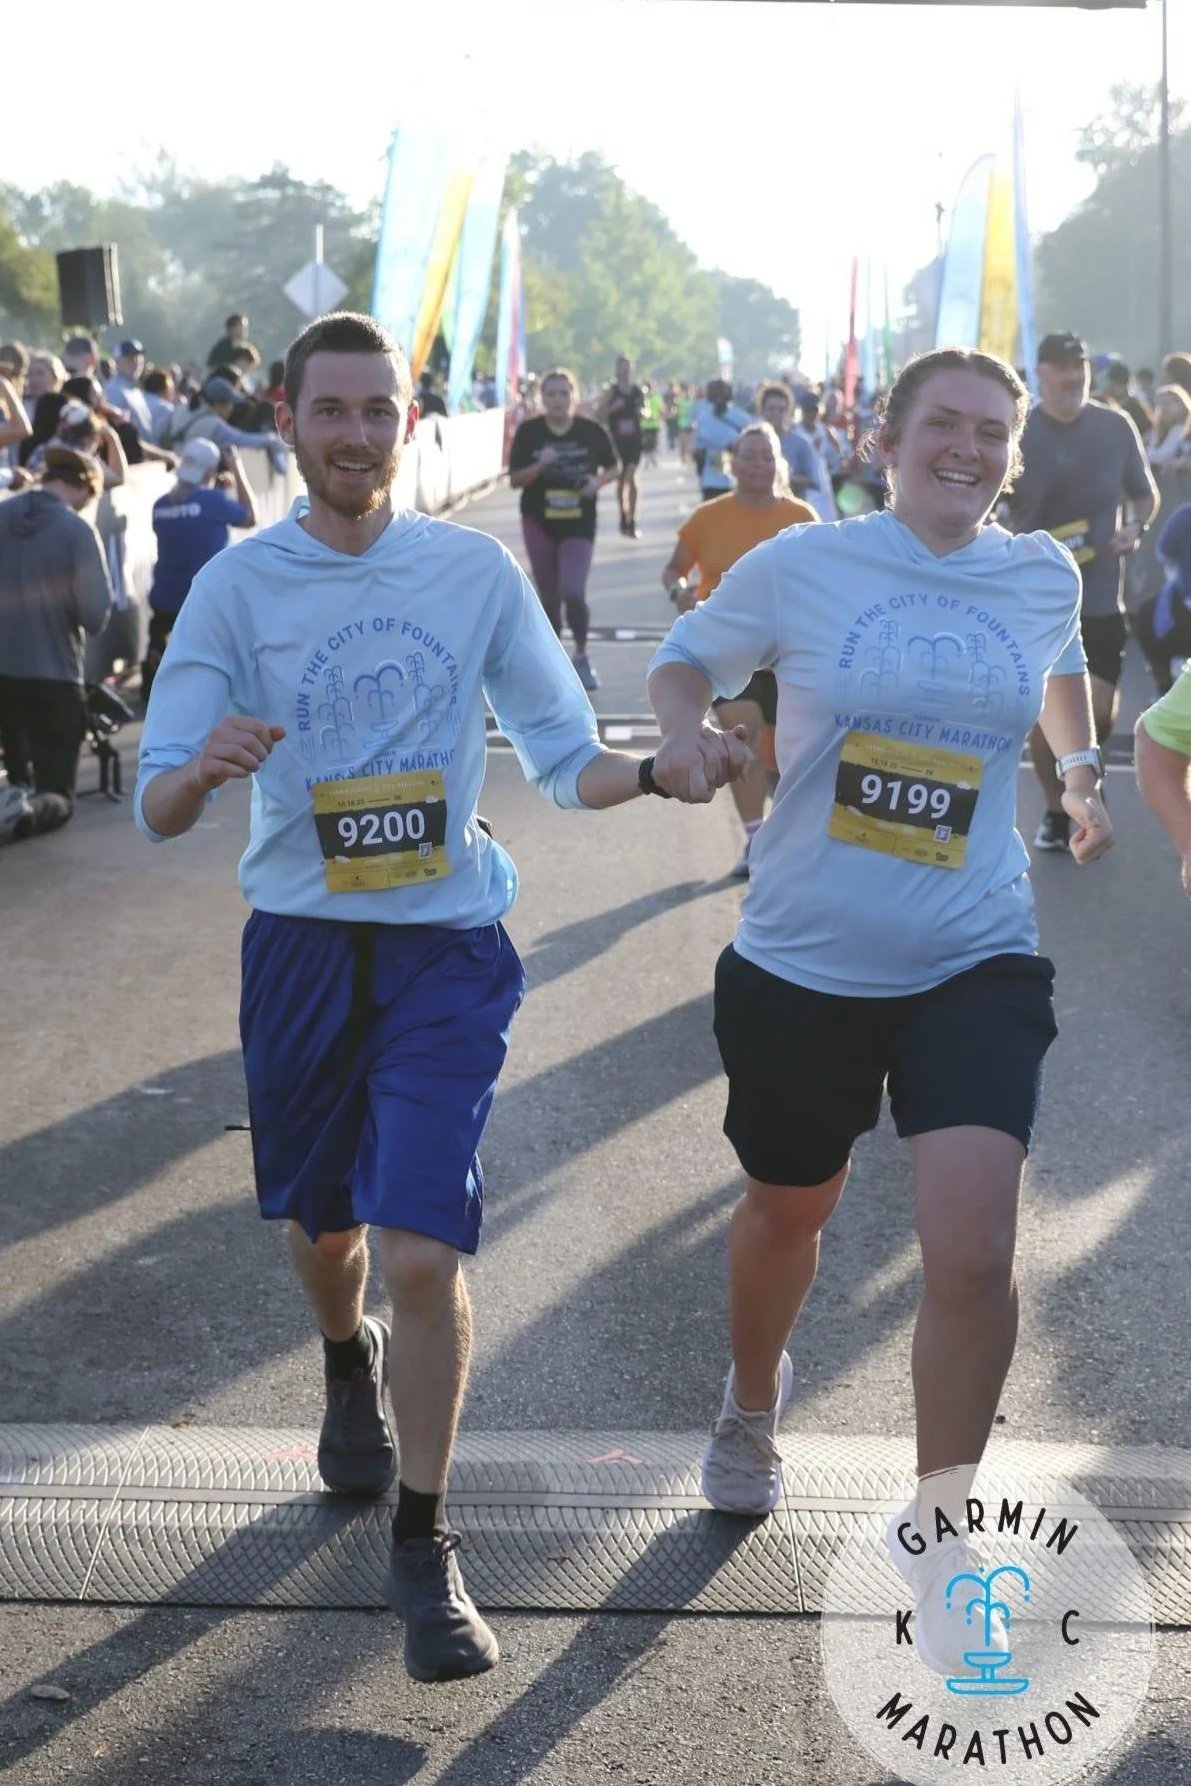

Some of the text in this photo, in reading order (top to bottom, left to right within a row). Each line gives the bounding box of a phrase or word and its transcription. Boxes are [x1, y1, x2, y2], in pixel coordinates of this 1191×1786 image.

[327, 619, 365, 652] CITY
[372, 616, 396, 632] OF
[839, 593, 1031, 697] RUN THE CITY OF FOUNTAINS
[301, 648, 329, 686] THE
[296, 692, 312, 732] RUN
[833, 713, 893, 734] KANSAS
[899, 720, 934, 740] CITY
[361, 758, 394, 777] CITY
[861, 774, 951, 820] 9199
[337, 808, 426, 848] 9200
